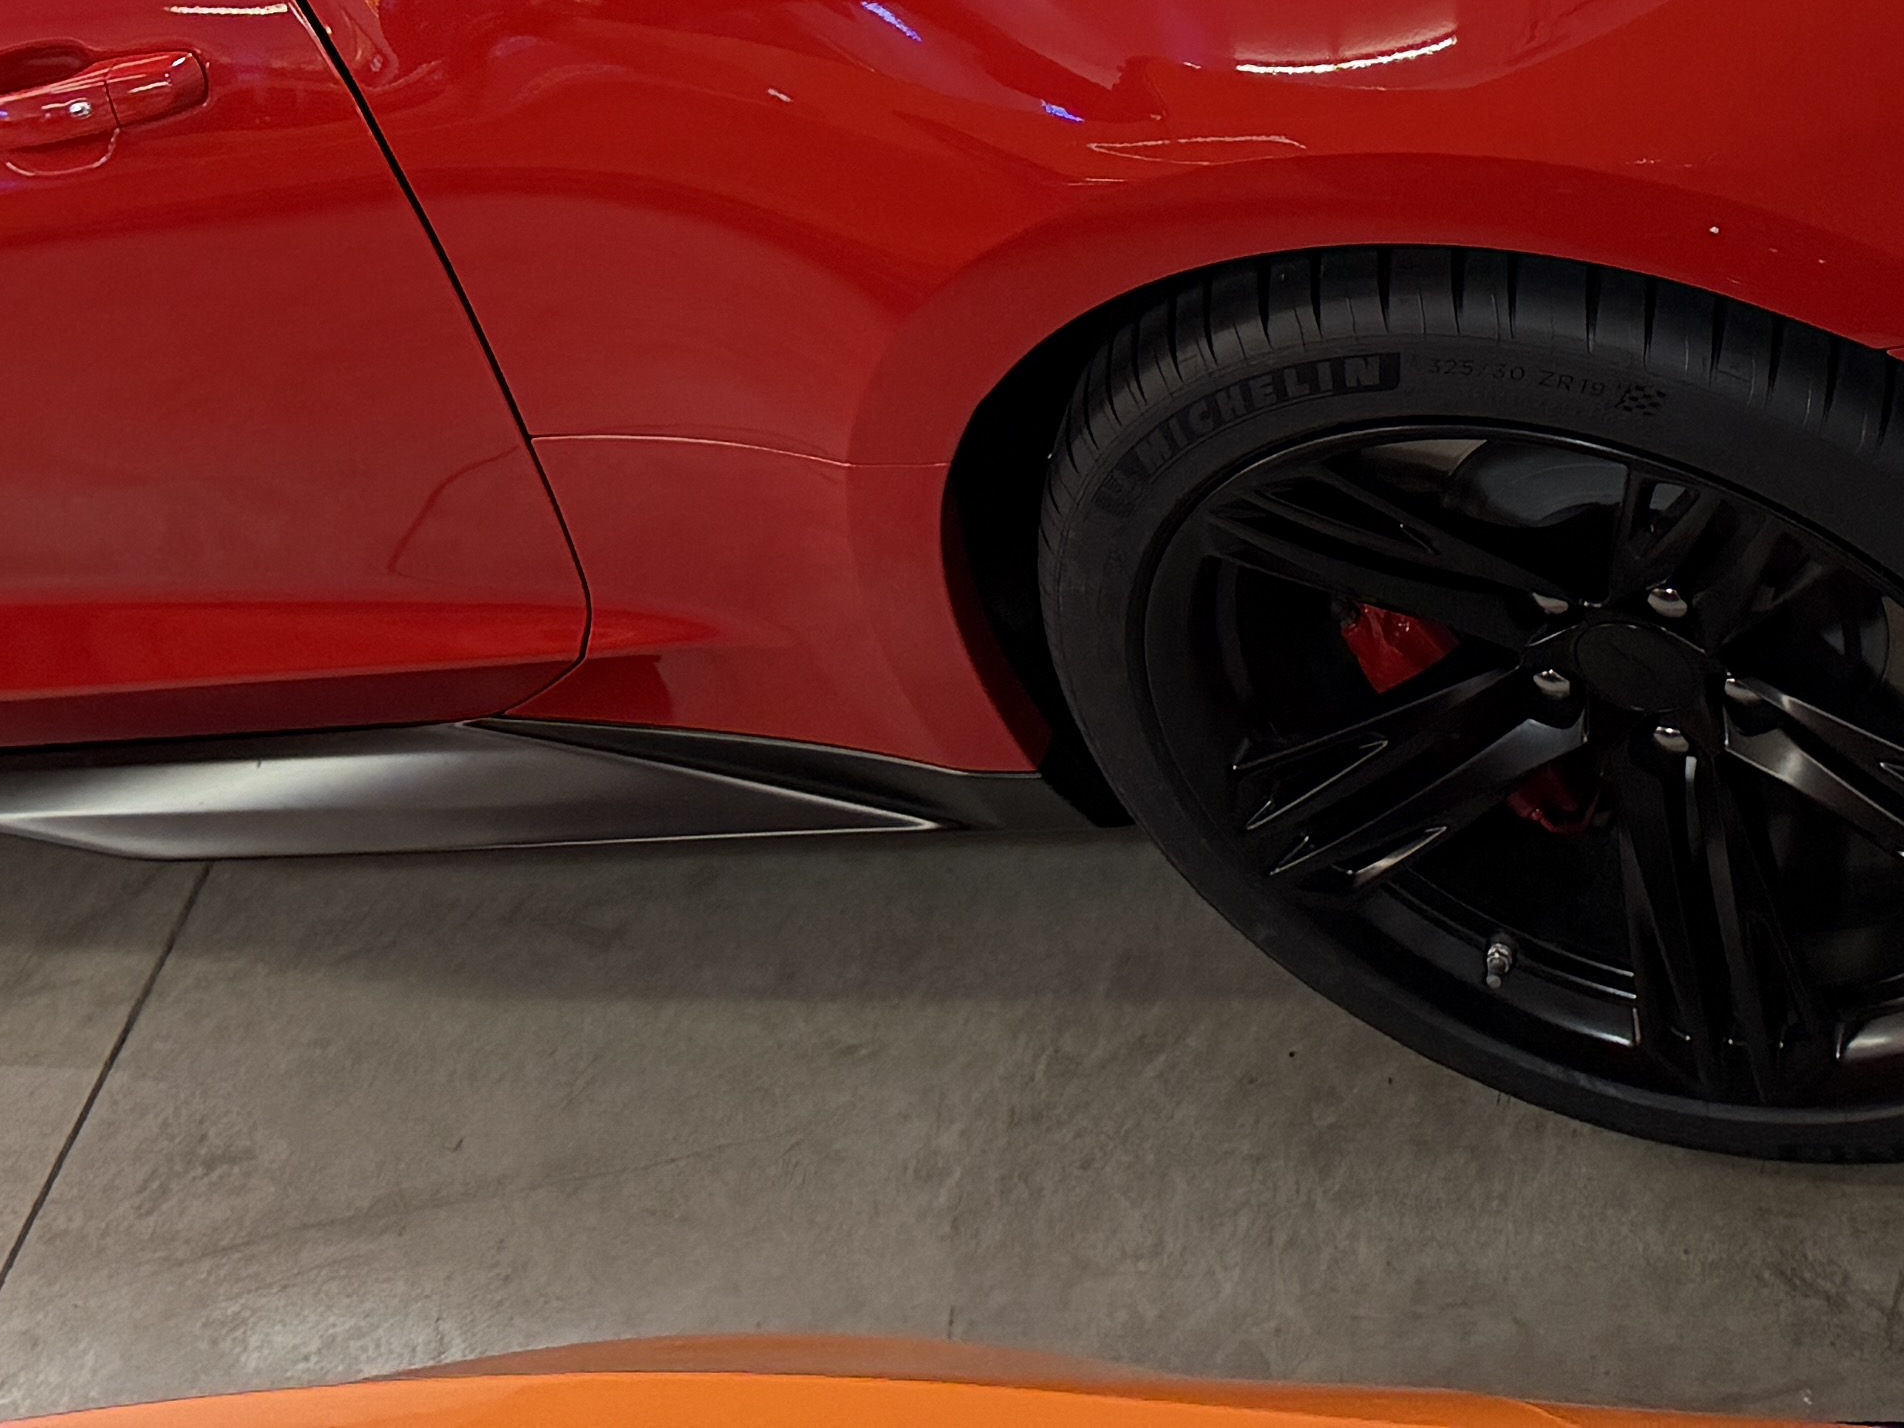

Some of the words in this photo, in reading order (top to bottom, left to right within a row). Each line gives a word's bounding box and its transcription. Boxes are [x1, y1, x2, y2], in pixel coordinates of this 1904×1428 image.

[1138, 354, 1384, 478] MICHELIN
[1427, 357, 1527, 383] 325/30
[1536, 368, 1606, 398] ZR19
